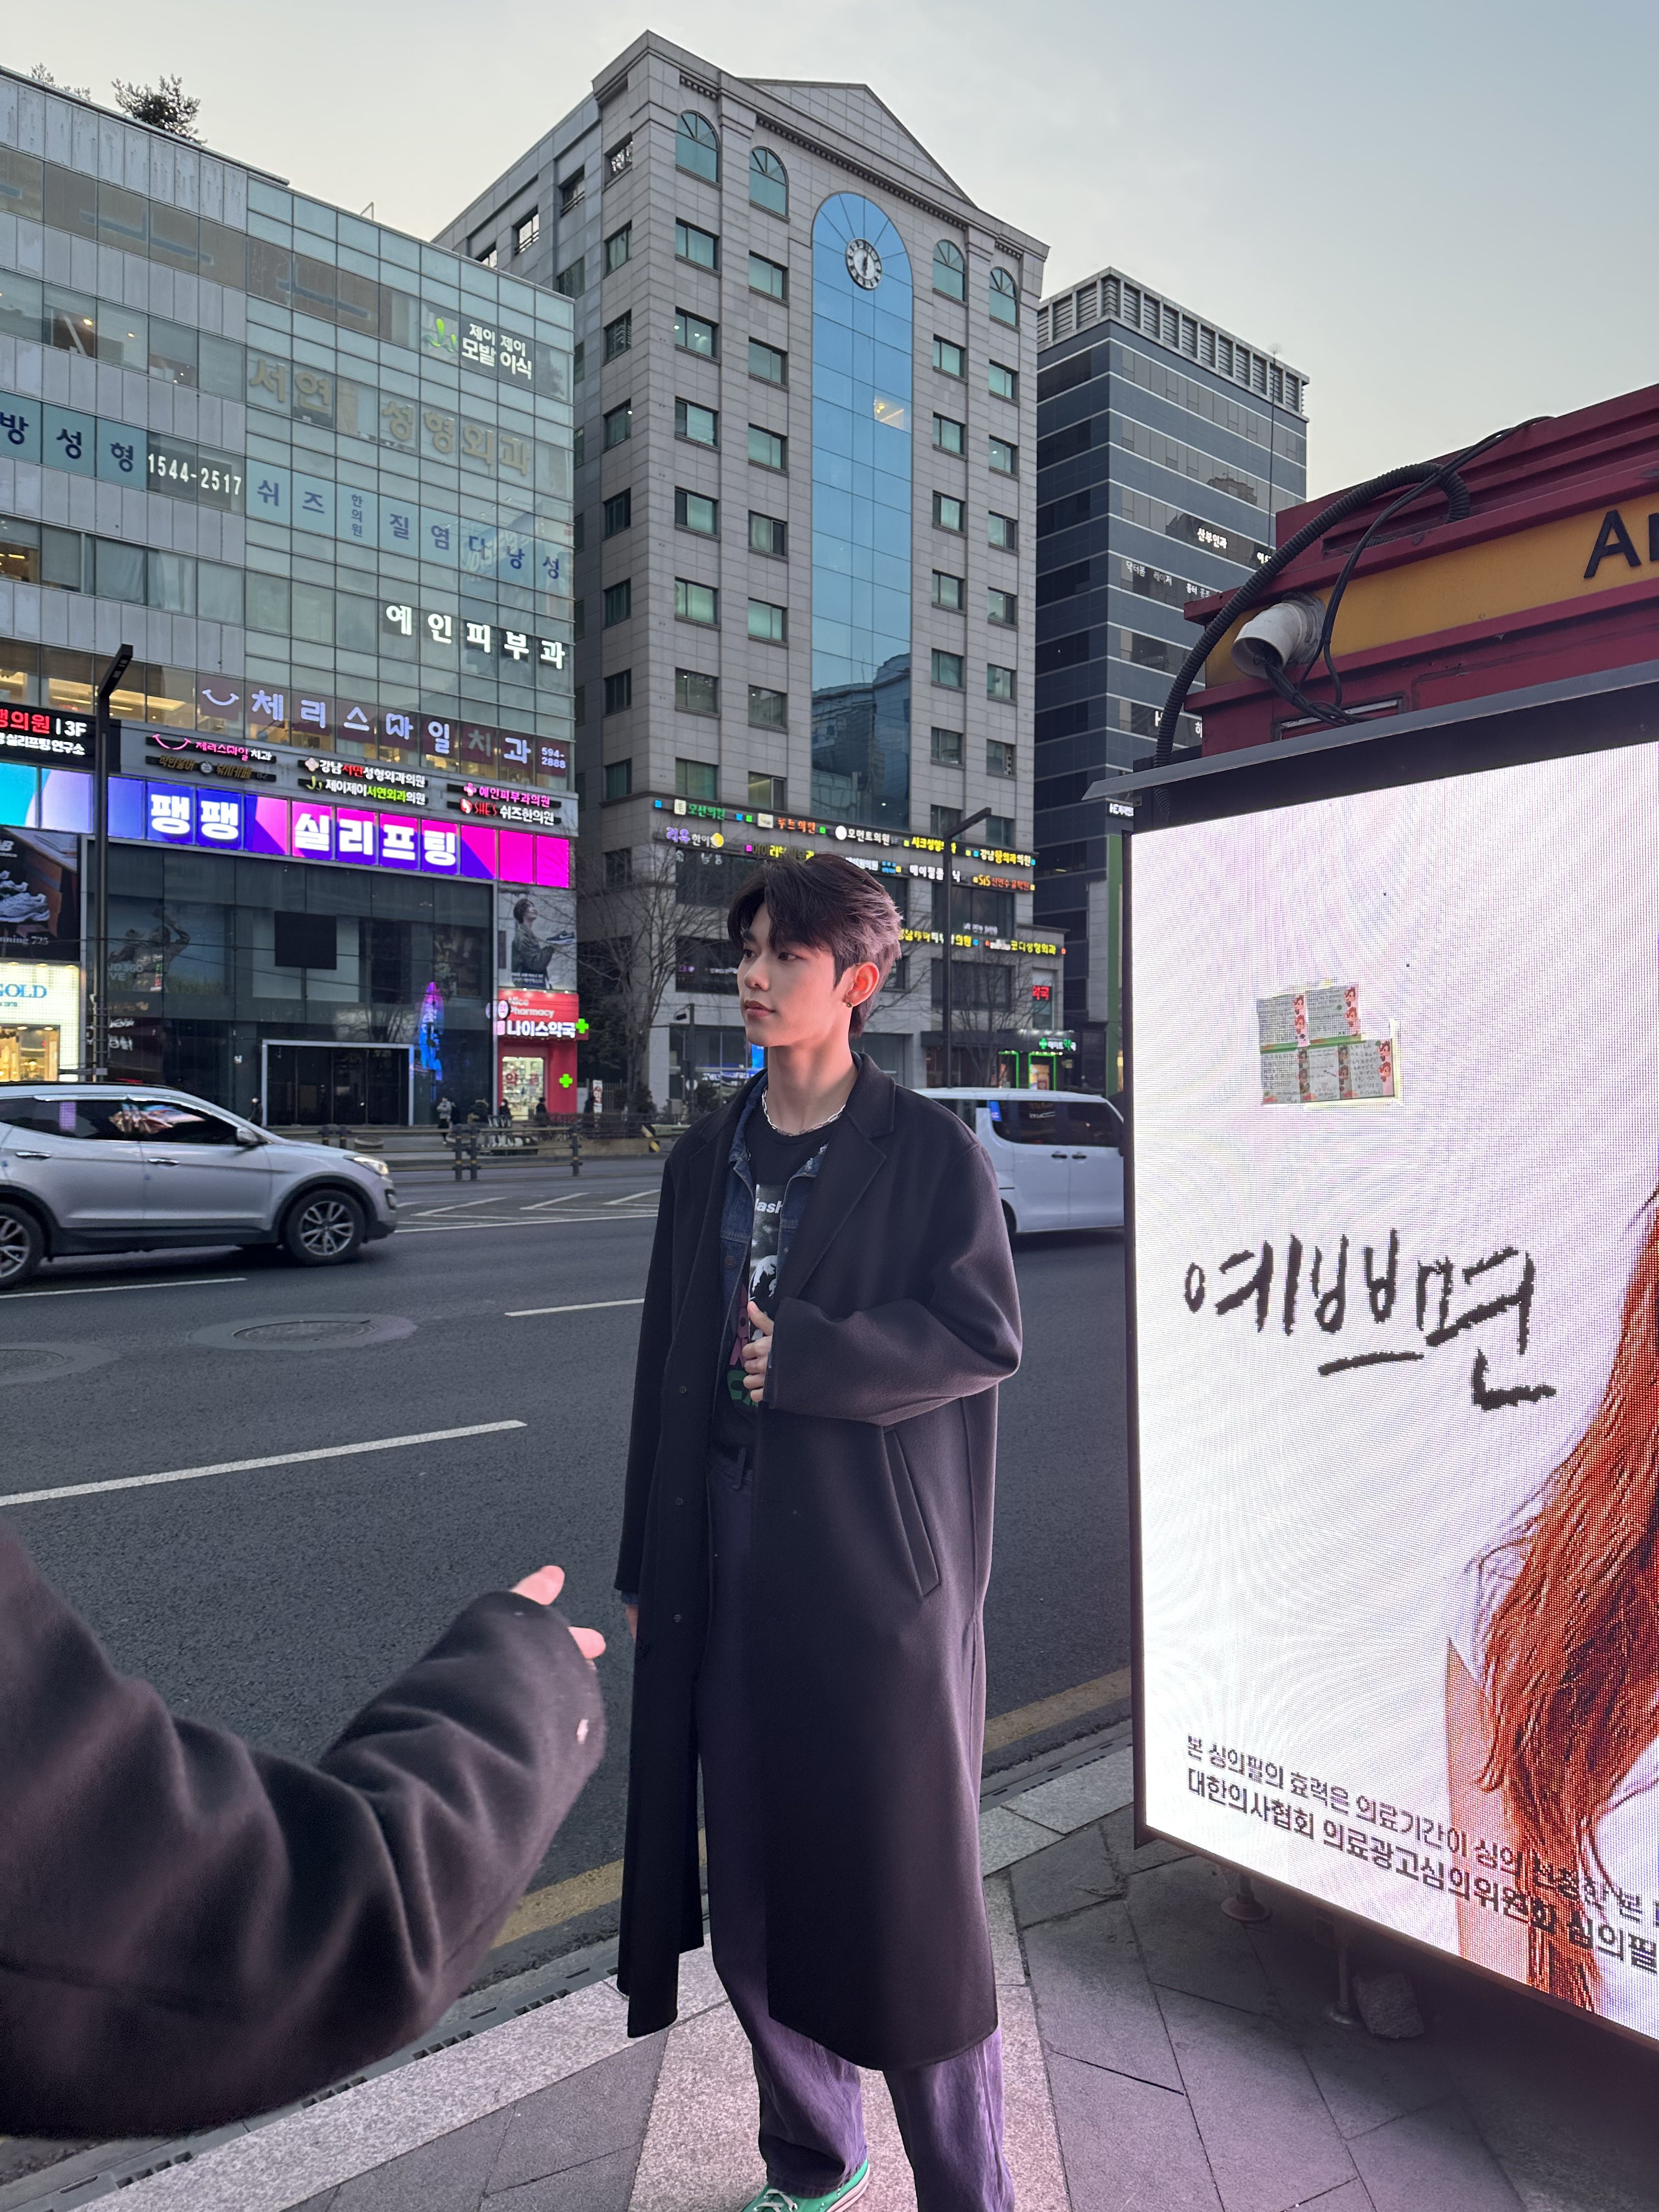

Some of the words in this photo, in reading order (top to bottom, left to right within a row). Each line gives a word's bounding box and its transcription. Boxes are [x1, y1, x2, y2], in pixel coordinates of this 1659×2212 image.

[461, 336, 496, 368] 모발
[500, 353, 532, 380] 이식
[469, 323, 495, 346] 제이
[500, 334, 526, 357] 제이
[250, 358, 329, 411] 서연
[381, 400, 531, 476] 성형외과
[148, 453, 242, 495] 1544-2517
[1197, 528, 1227, 549] 산부인과
[386, 603, 566, 669] 예인피부과
[479, 786, 551, 808] 예인피부과의원
[500, 805, 554, 826] 쉬즈한의원
[507, 1020, 576, 1038] 나이스약국
[1188, 1768, 1314, 1840] 대한의사협회
